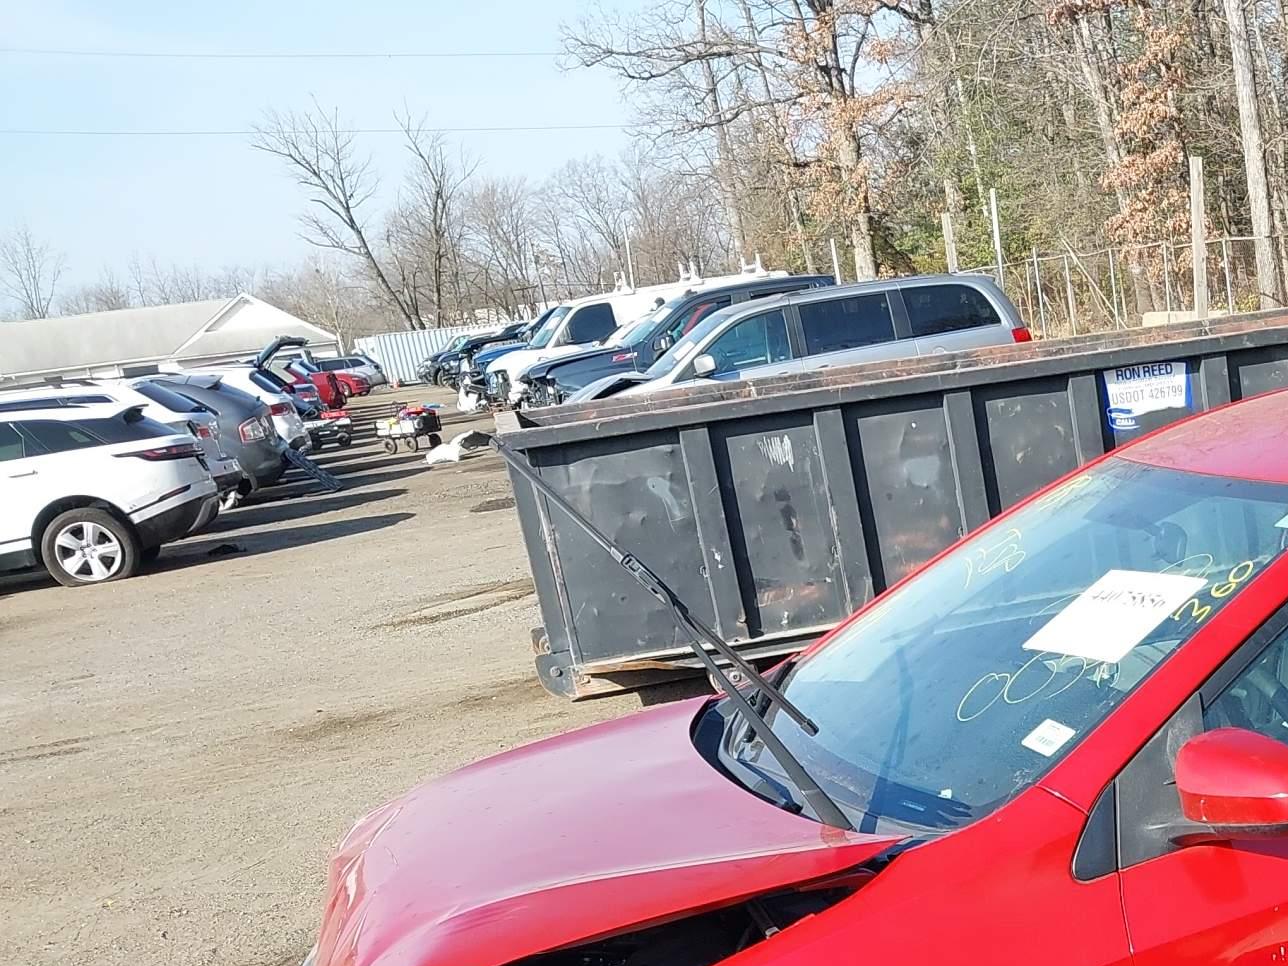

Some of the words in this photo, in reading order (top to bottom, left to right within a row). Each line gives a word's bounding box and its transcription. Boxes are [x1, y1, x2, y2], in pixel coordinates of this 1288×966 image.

[1115, 366, 1141, 381] RON
[1142, 363, 1174, 378] REED
[1111, 390, 1145, 406] USDOT
[1148, 384, 1184, 400] 426799
